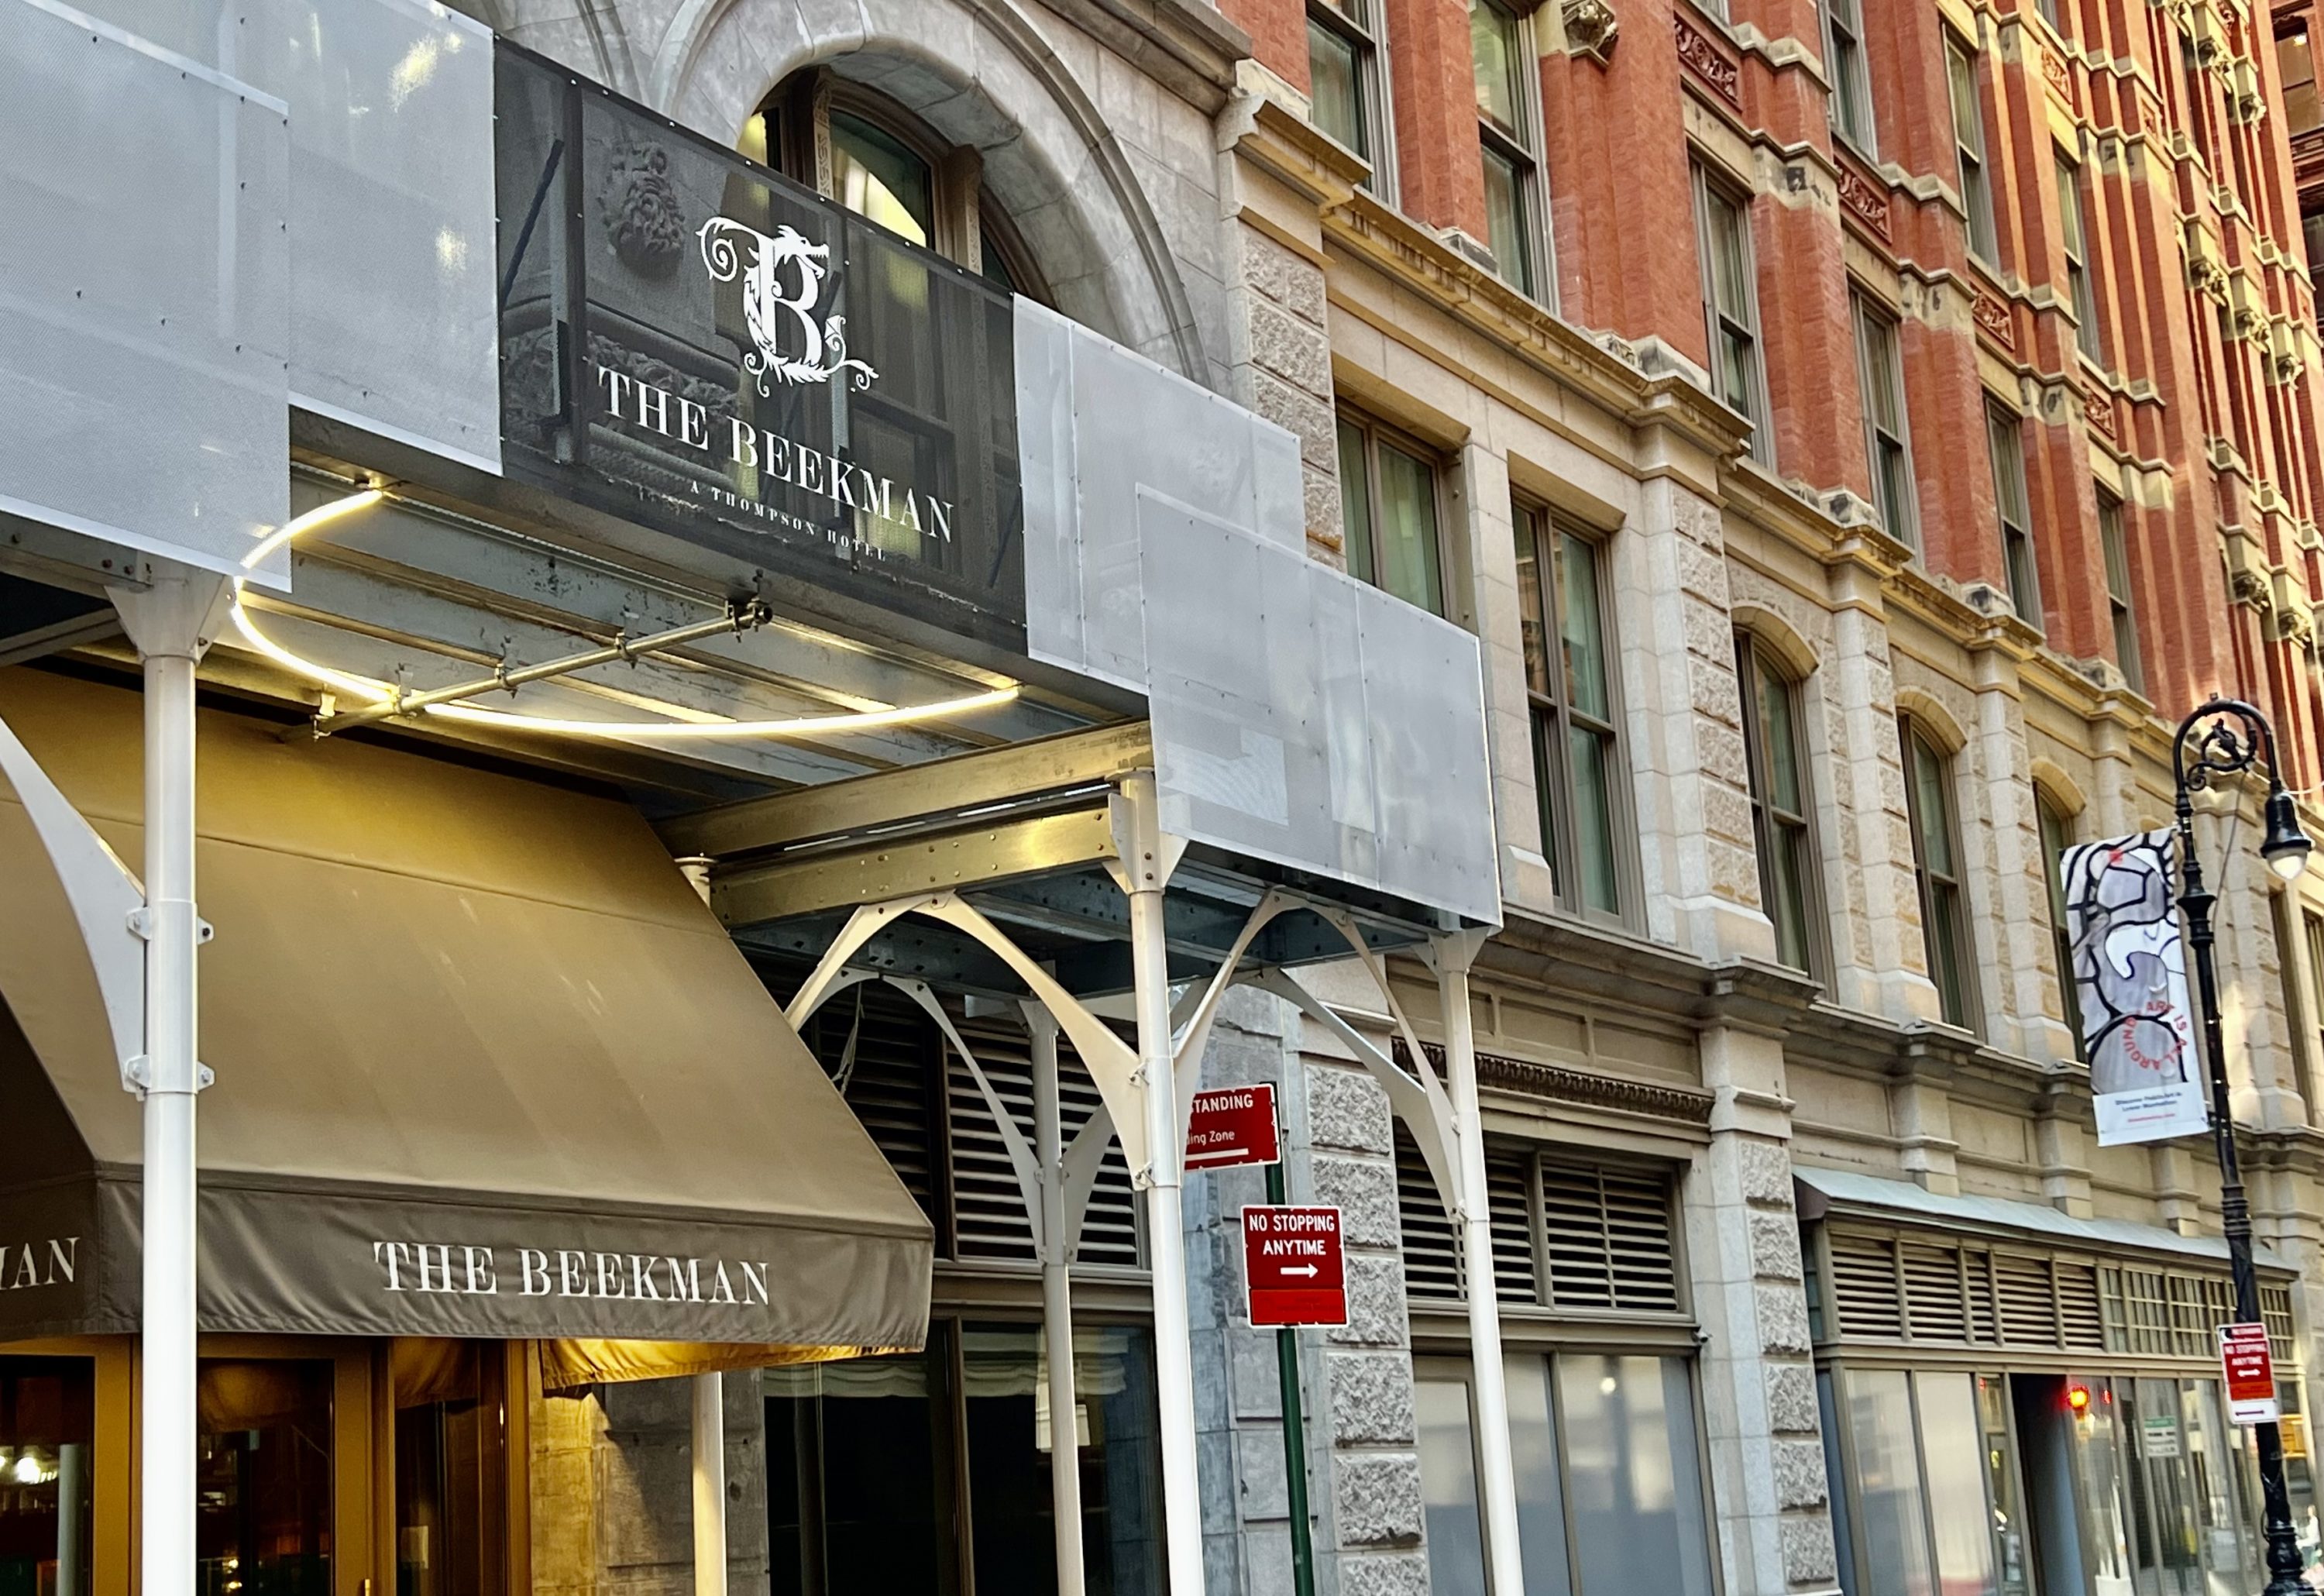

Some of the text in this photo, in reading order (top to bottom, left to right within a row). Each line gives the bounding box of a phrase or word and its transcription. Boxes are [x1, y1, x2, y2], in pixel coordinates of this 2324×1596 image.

[598, 366, 954, 543] THE BEEKMAN
[690, 481, 887, 562] A THOMPSON HOTEL
[1191, 1094, 1253, 1113] TANDING
[1209, 1130, 1235, 1143] Zone
[1249, 1214, 1335, 1233] NO STOPPING
[1262, 1240, 1326, 1256] ANYTIME
[373, 1242, 769, 1305] THE BEEKMAN
